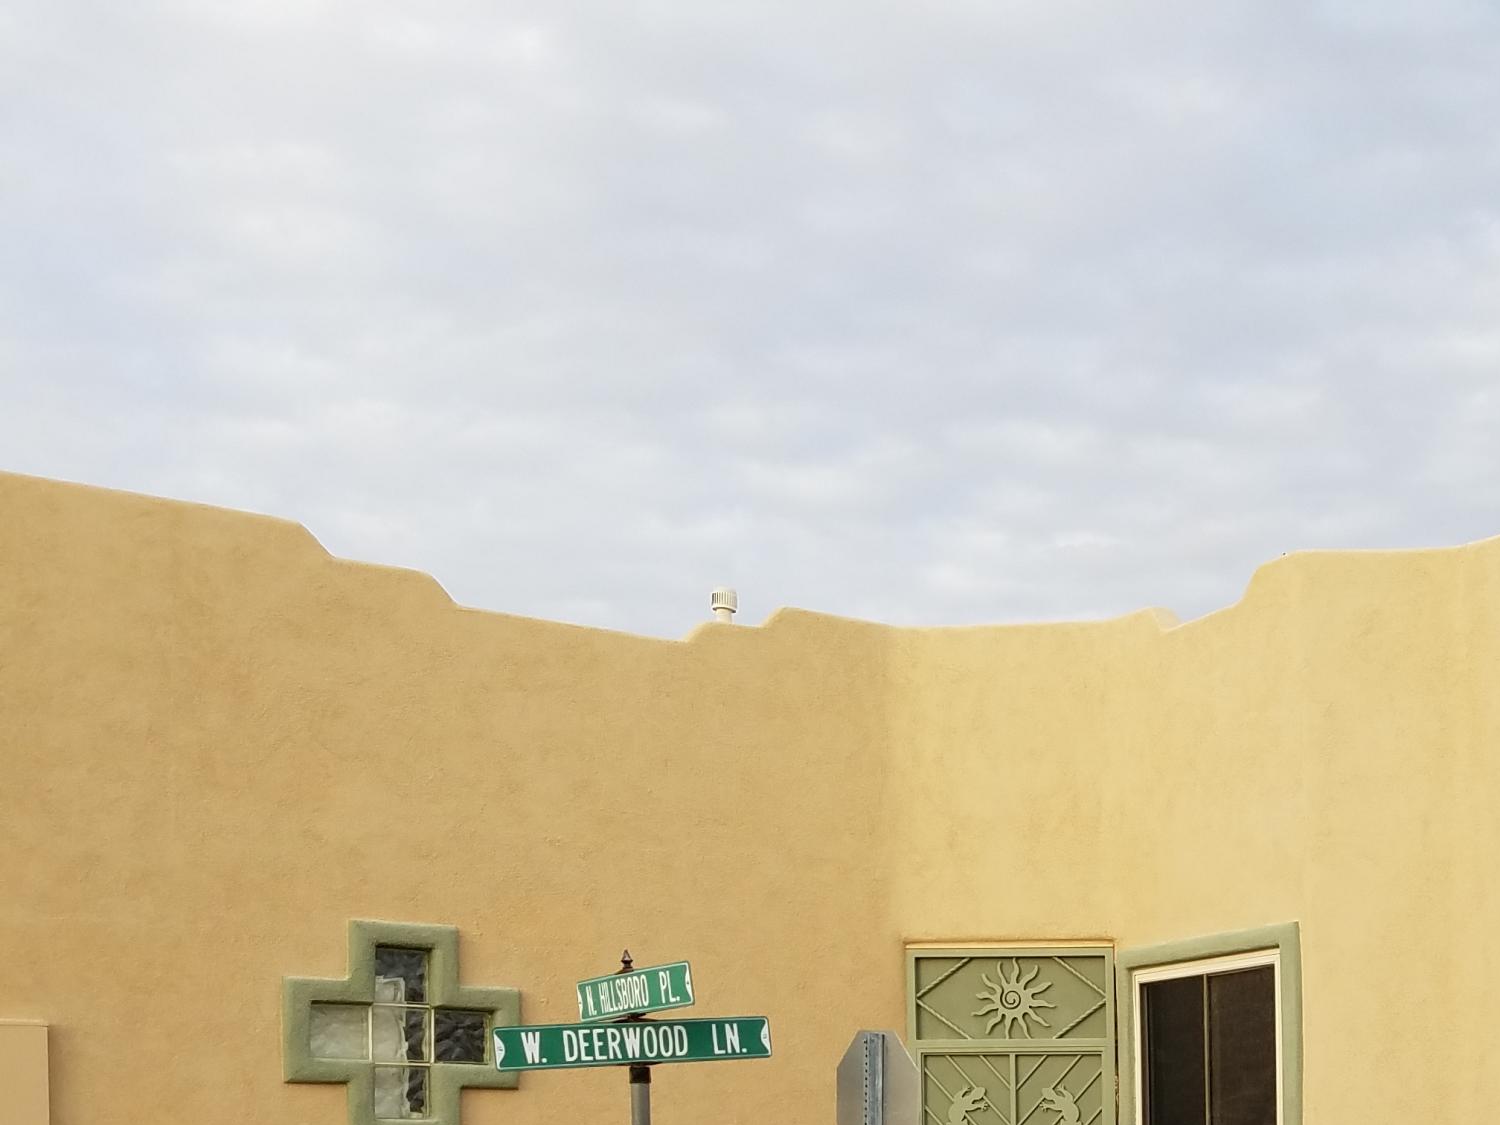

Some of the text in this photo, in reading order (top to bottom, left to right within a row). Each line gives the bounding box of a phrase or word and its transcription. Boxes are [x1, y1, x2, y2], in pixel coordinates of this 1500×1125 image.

[586, 970, 680, 1016] N. HILLSBORO PL.
[521, 1023, 747, 1064] W. DEERWOOD LN.
